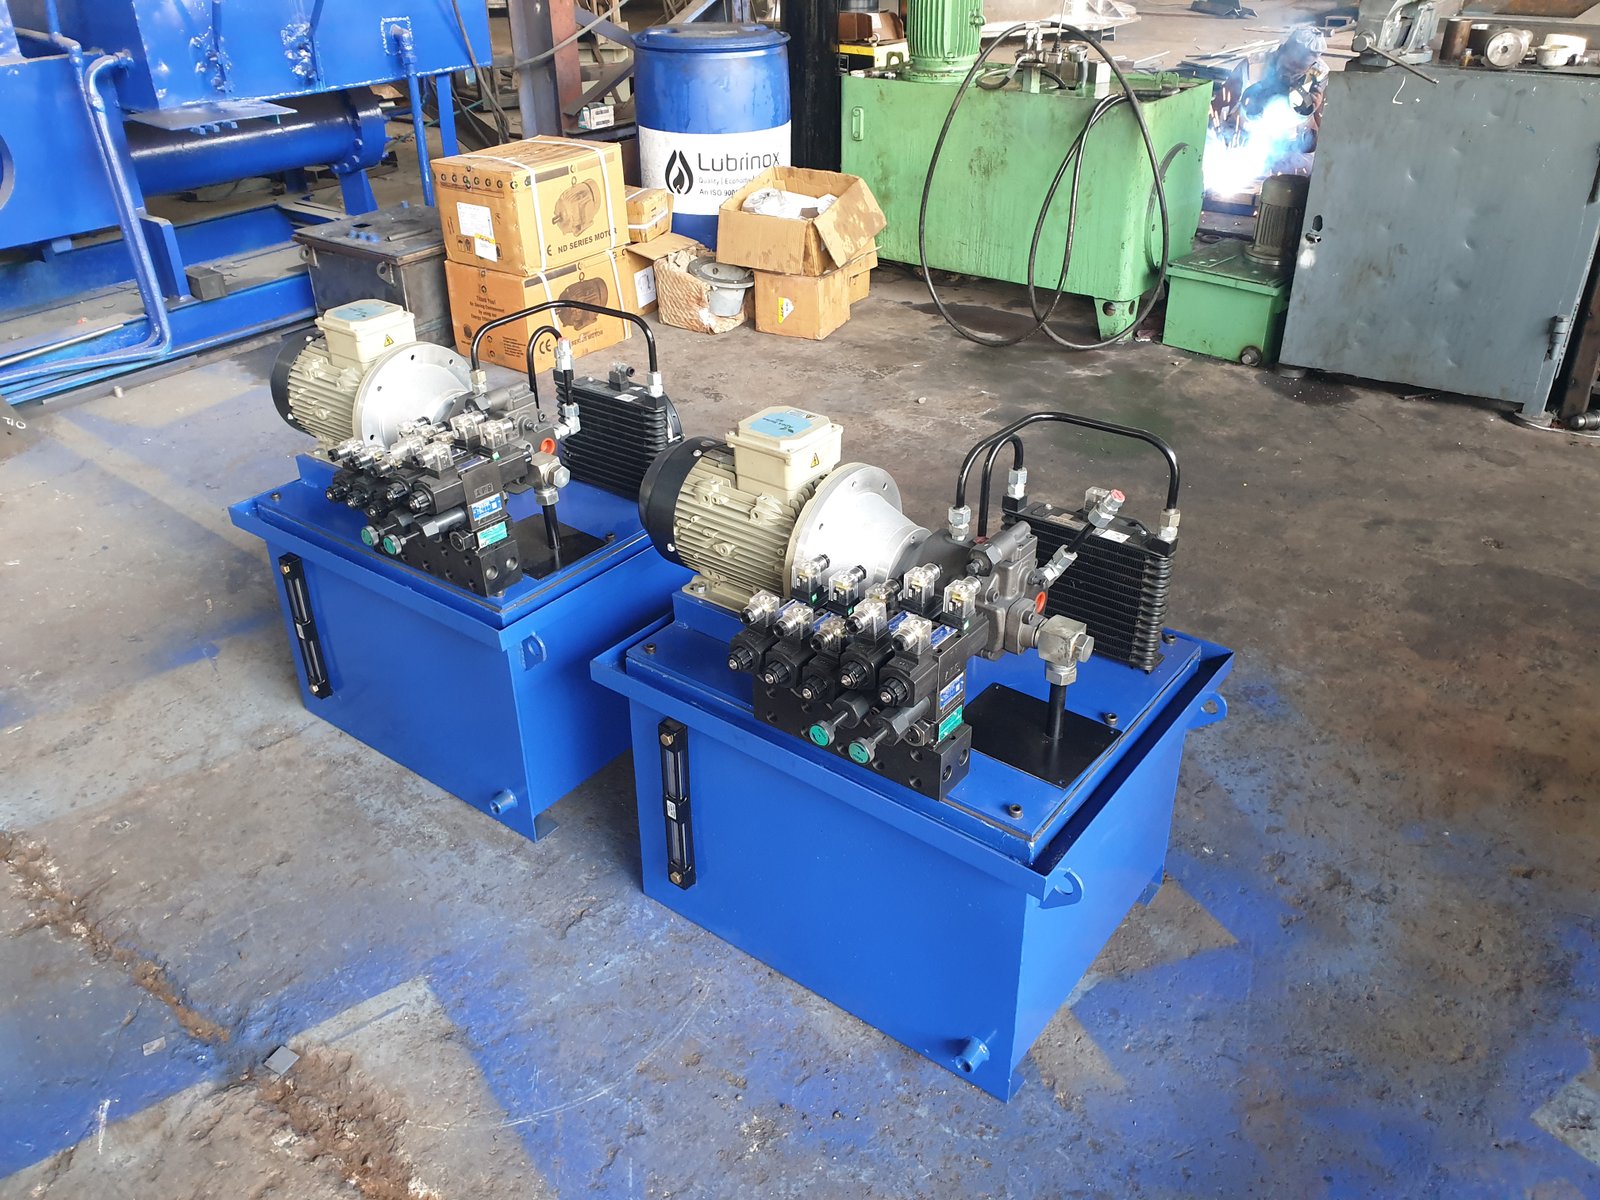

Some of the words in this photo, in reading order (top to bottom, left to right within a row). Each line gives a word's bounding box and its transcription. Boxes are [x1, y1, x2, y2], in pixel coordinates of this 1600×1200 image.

[698, 152, 779, 171] Lubrinox
[558, 244, 568, 254] ND
[569, 235, 593, 250] SERIES
